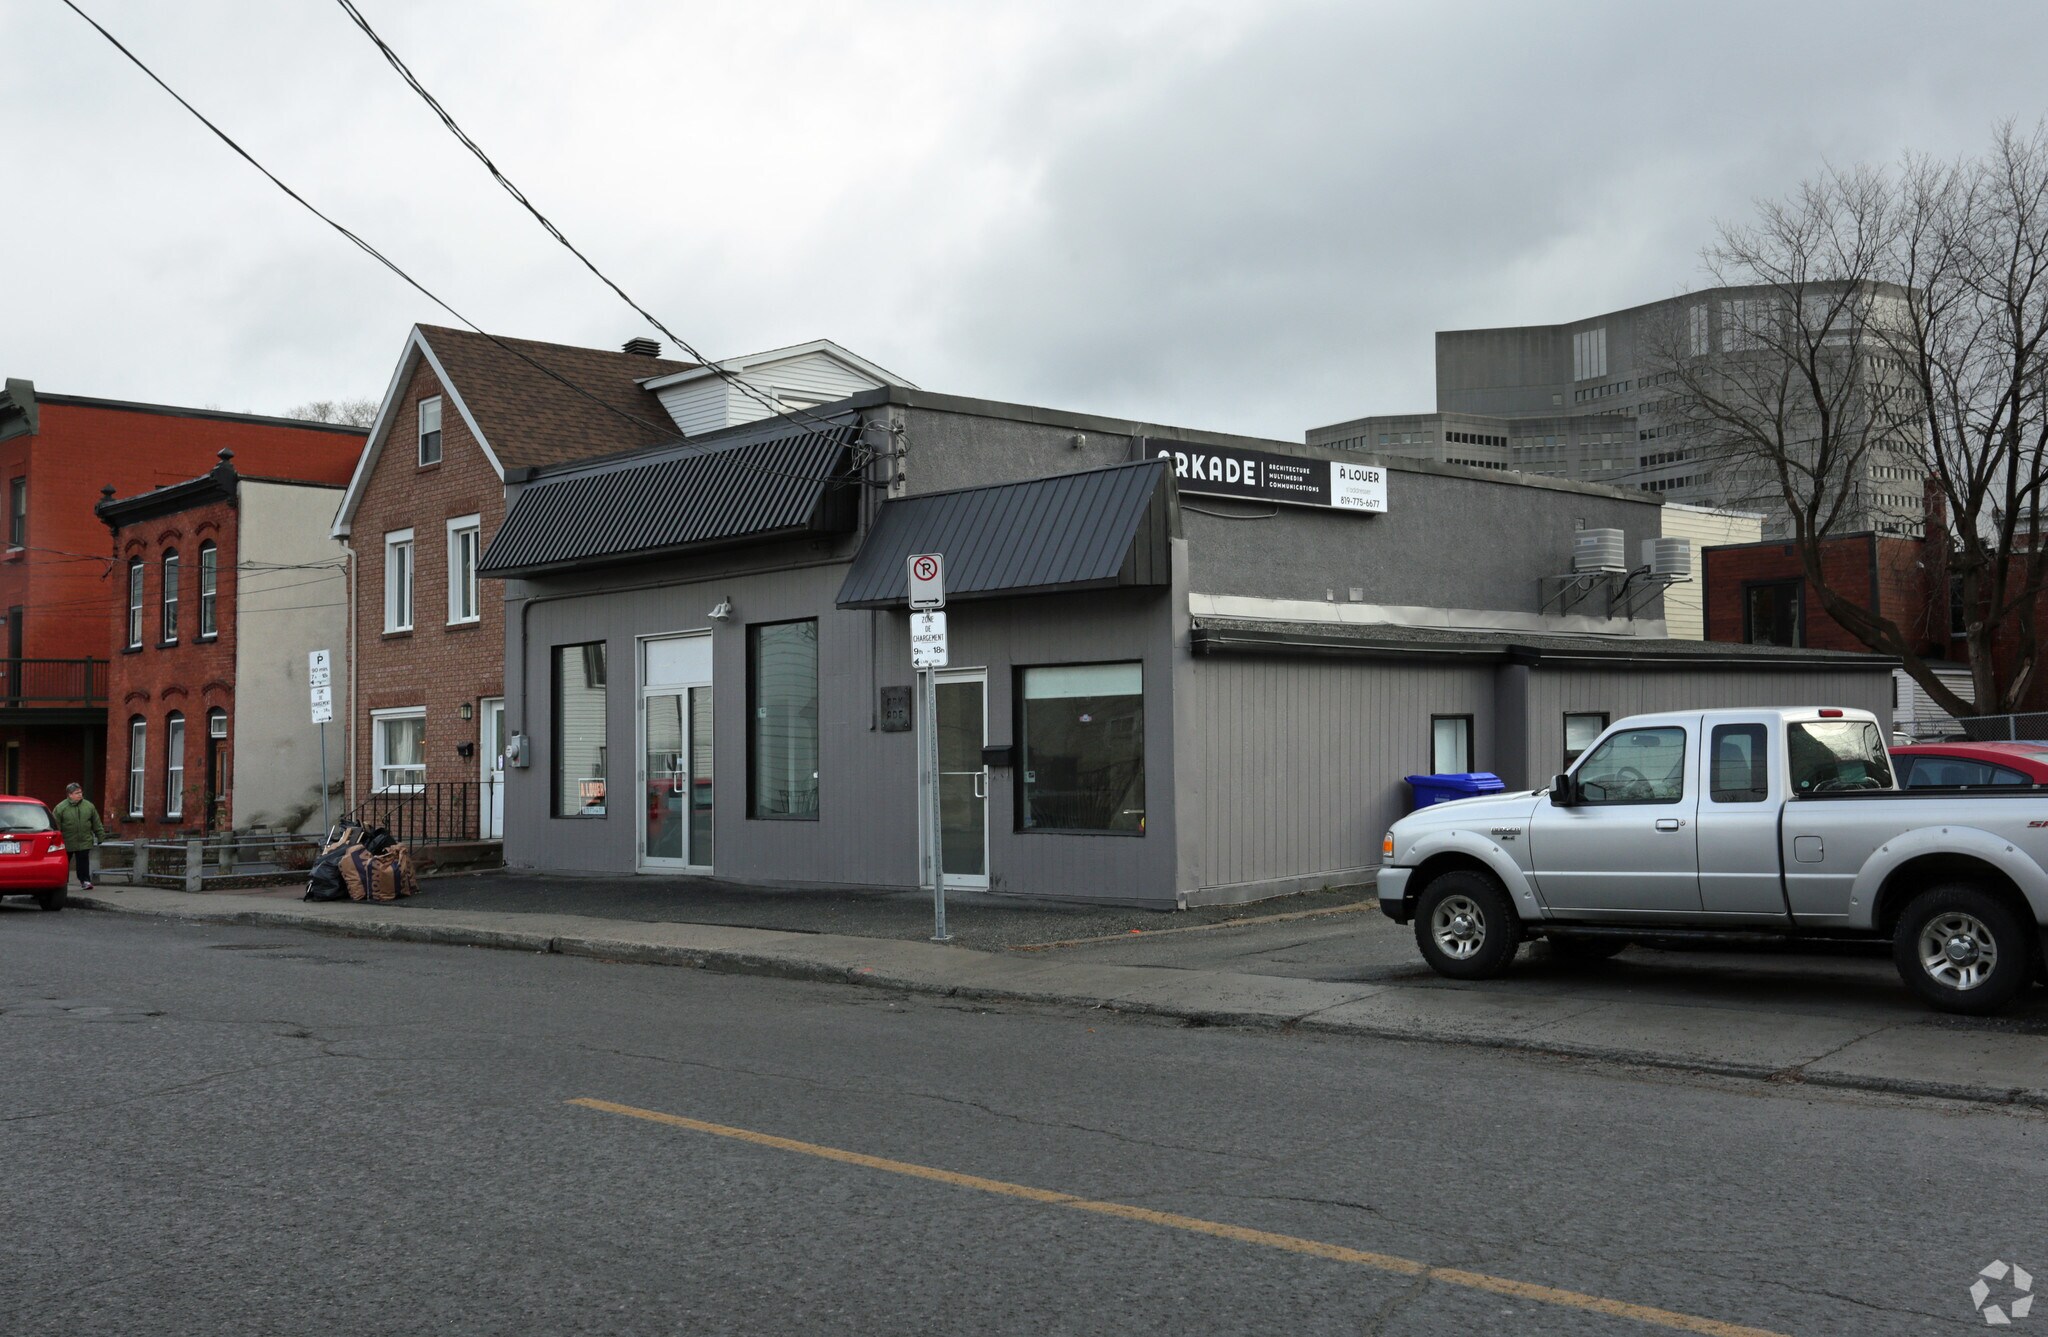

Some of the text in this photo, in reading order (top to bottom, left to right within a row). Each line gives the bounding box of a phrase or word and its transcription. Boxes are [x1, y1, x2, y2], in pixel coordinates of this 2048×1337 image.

[1269, 463, 1310, 474] ARCHITECTURE
[1269, 473, 1303, 482] MULTIMEDIA
[1340, 465, 1380, 483] À LOUER
[1269, 481, 1319, 492] COMMUNICATIONS
[1340, 496, 1380, 508] 819-775-6677
[922, 563, 931, 576] P
[921, 615, 934, 624] ZONE
[913, 633, 944, 642] CHARGEMENT
[317, 655, 324, 665] P
[886, 710, 904, 720] ADE
